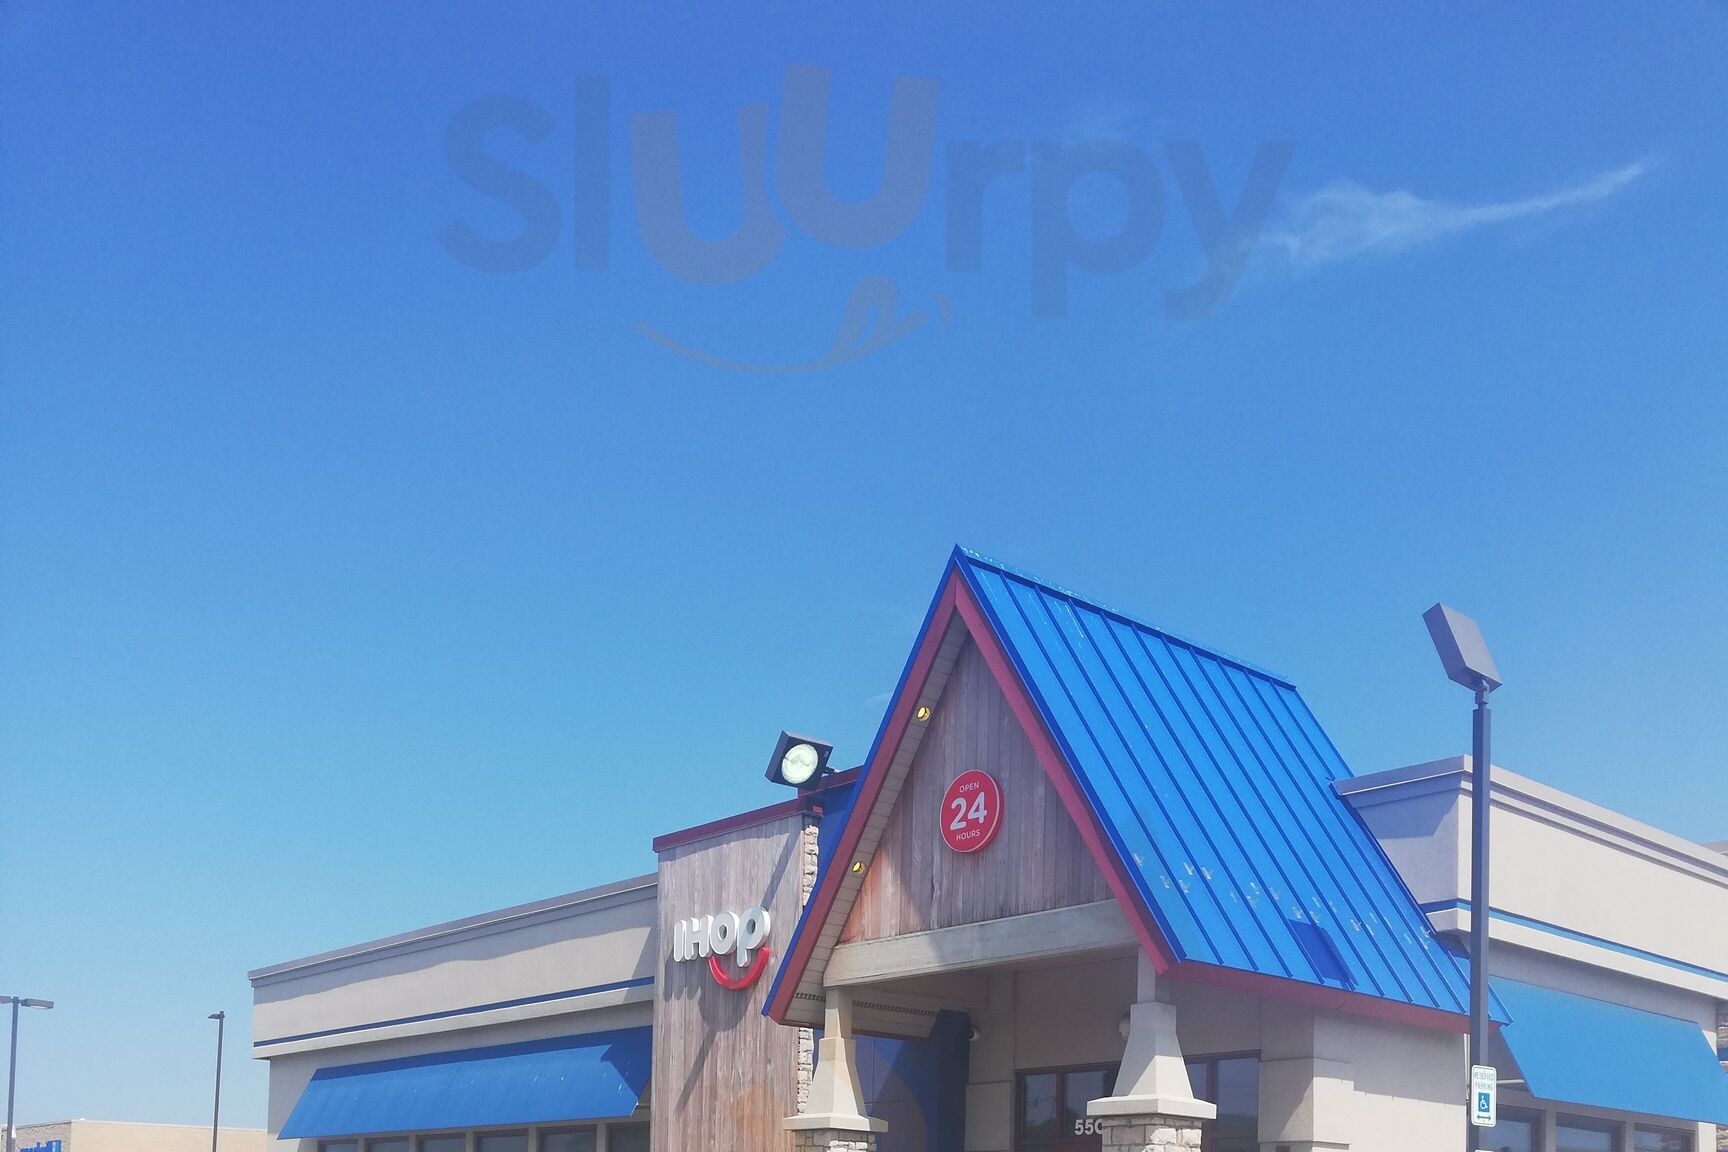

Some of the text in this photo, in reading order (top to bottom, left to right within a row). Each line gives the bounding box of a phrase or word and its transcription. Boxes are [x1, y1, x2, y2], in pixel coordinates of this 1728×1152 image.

[959, 781, 980, 792] OPEN
[949, 791, 988, 831] 24
[955, 829, 981, 841] HOURS
